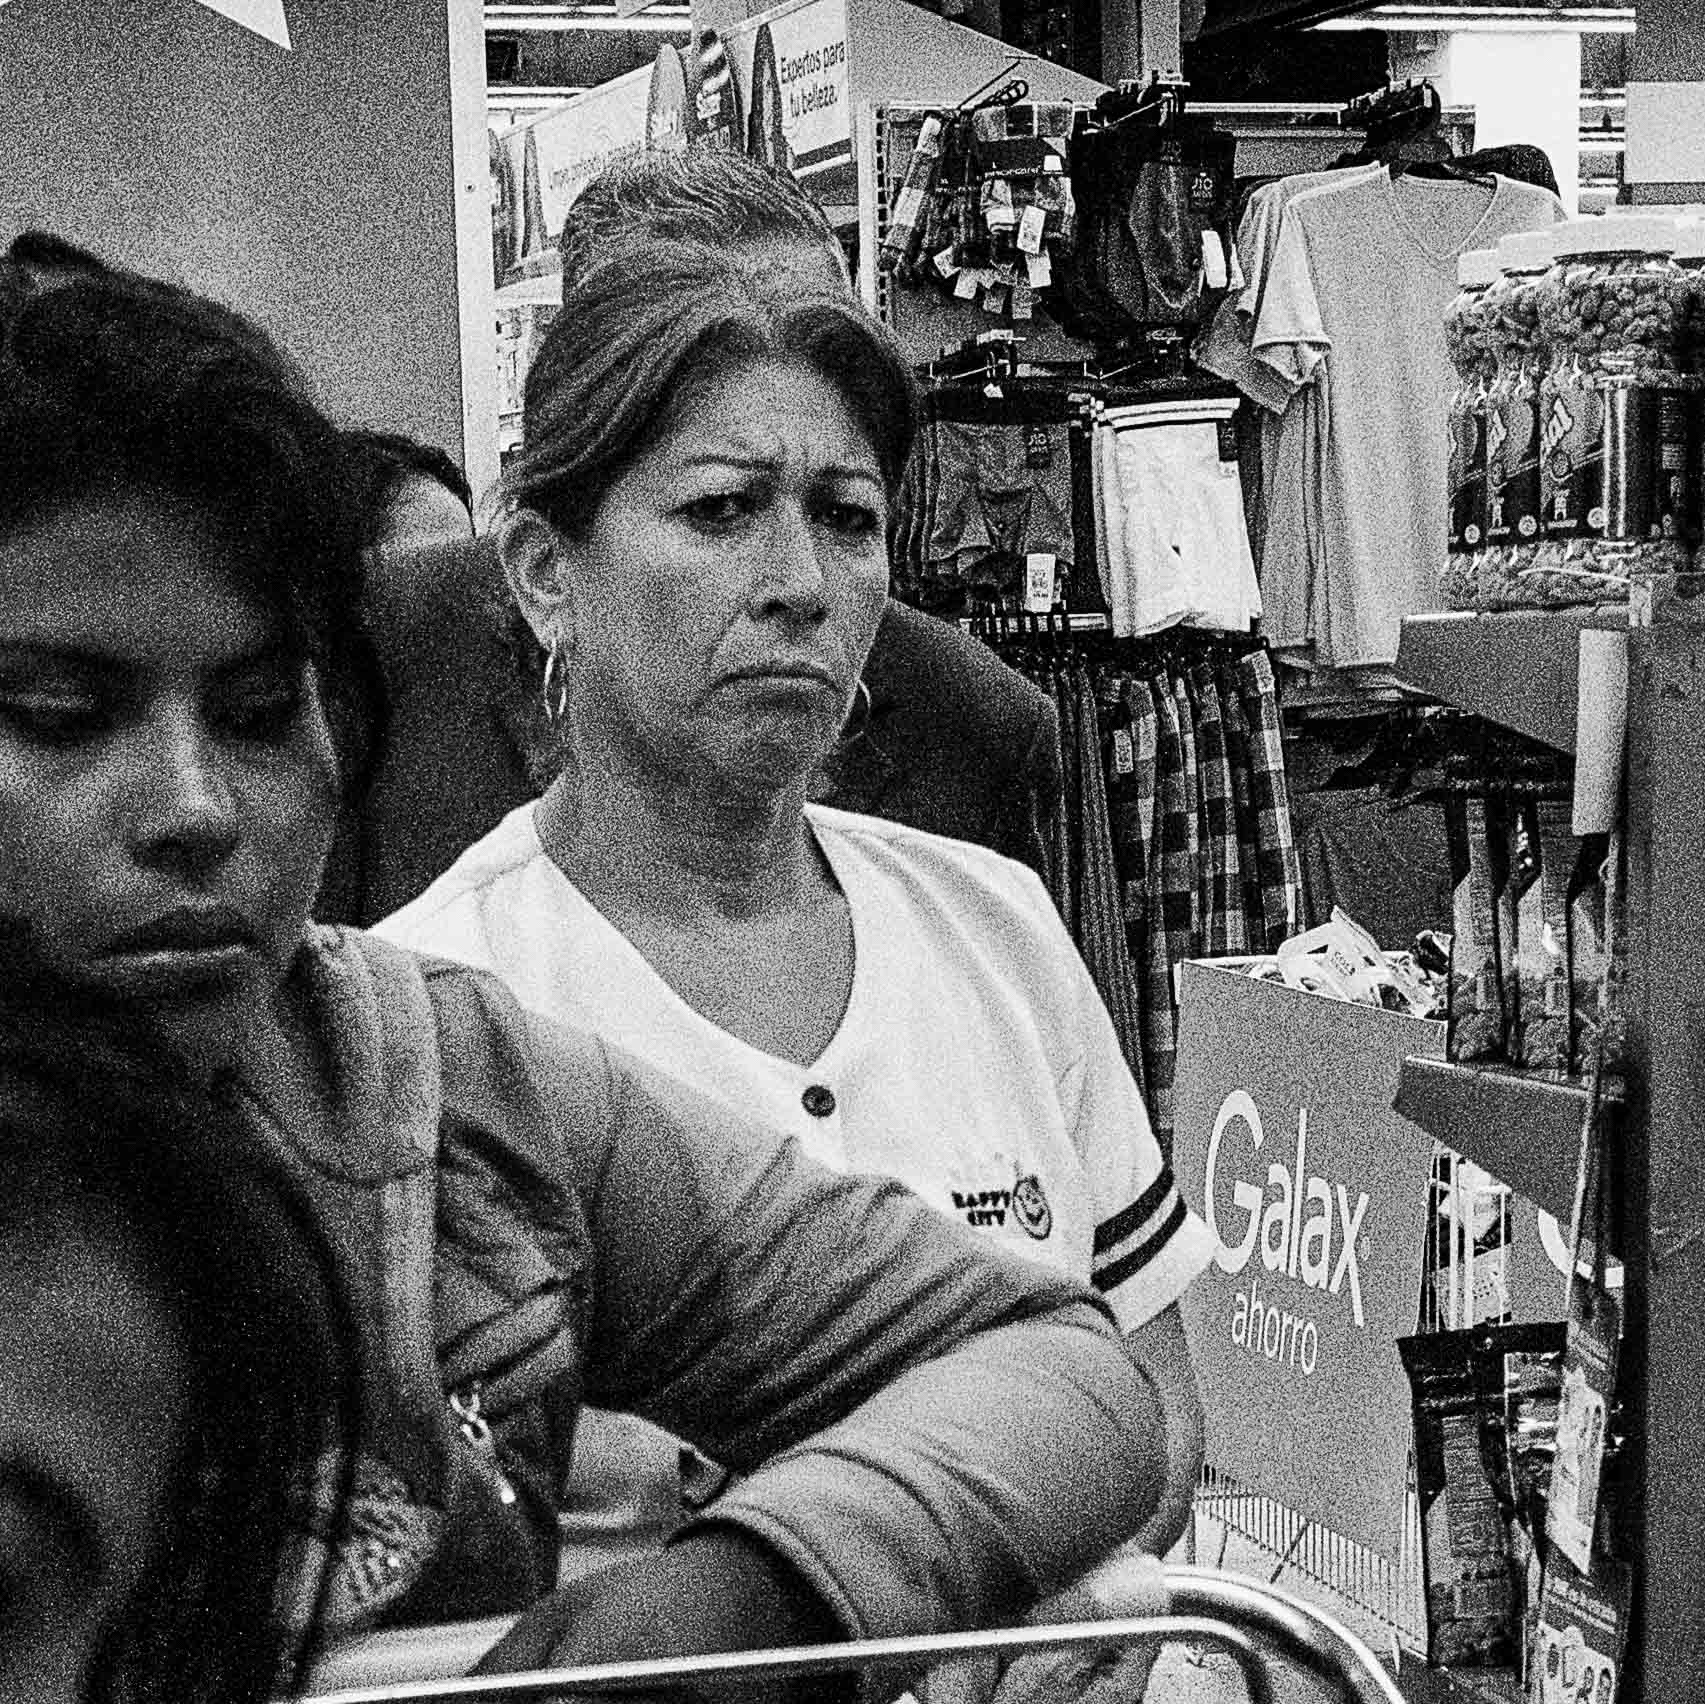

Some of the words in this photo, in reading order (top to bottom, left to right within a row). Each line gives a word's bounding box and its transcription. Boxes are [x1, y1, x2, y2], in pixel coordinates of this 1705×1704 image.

[823, 41, 845, 73] para
[1204, 1089, 1370, 1328] Galax
[1231, 1280, 1319, 1376] ahorro
